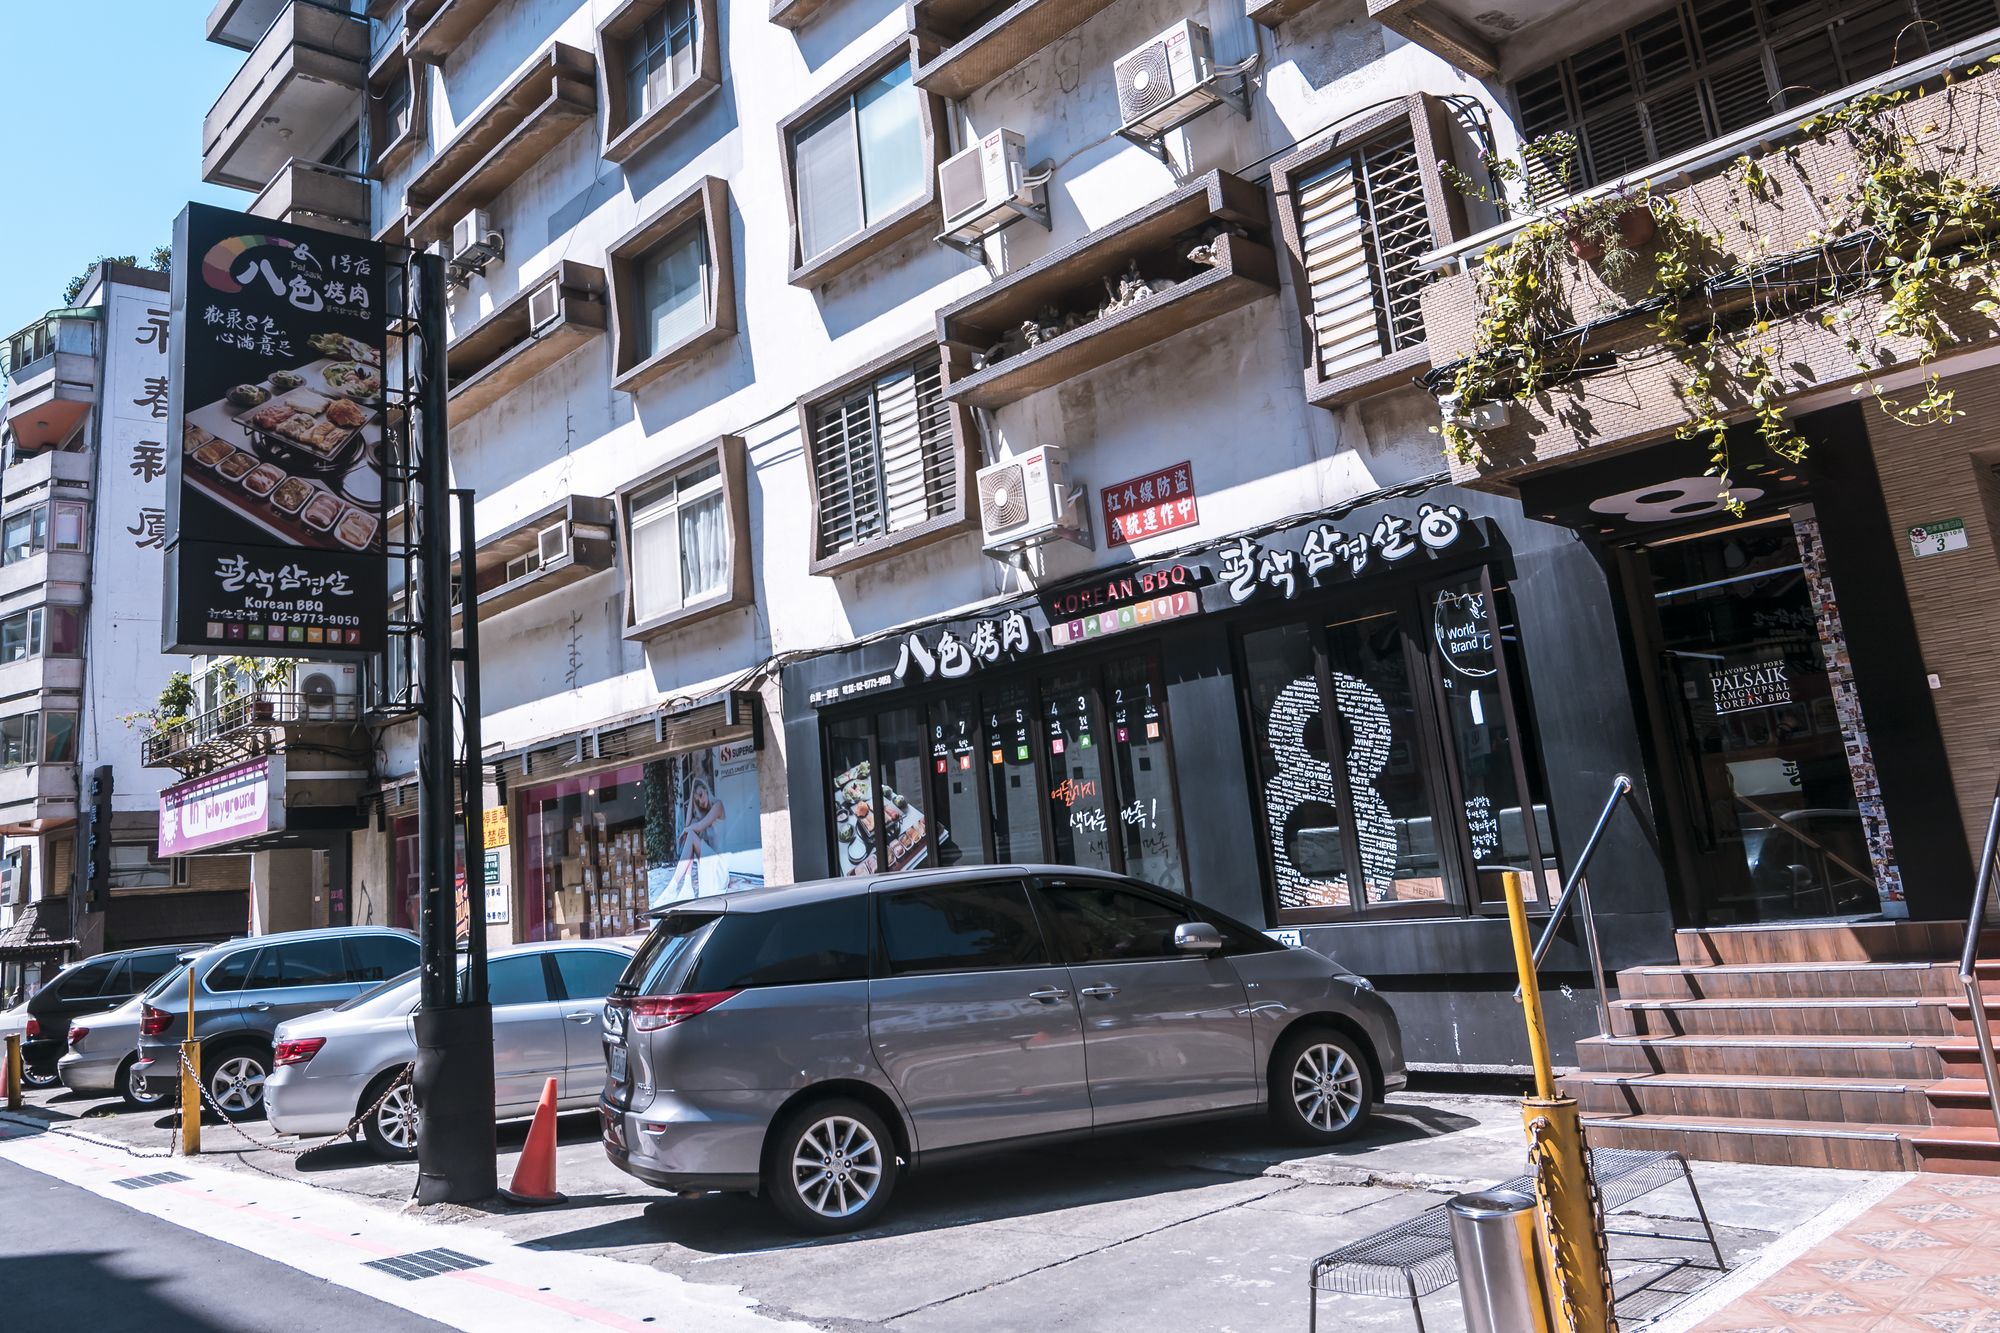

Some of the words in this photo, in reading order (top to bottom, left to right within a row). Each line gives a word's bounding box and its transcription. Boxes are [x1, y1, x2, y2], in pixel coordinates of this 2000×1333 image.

[237, 258, 370, 312] 八色烤肉
[1107, 468, 1190, 513] 紅外線防盜
[1111, 497, 1193, 542] 系統運作中
[1936, 538, 1945, 552] 3
[1218, 513, 1417, 604] 팔색삼겹살
[214, 554, 354, 598] 팔색삼겹살
[1053, 578, 1134, 617] KOREAN
[1143, 564, 1187, 593] BBQ
[245, 596, 294, 611] Korean
[296, 599, 324, 612] BBQ
[272, 612, 360, 625] 02-8773-9050
[1446, 621, 1476, 640] World
[894, 609, 1030, 679] 八色烤肉
[1450, 636, 1478, 654] Brand
[1715, 666, 1748, 677] FLAVORS
[1750, 663, 1760, 671] OF
[1763, 660, 1785, 668] PORK
[1340, 681, 1367, 690] CURRY
[1711, 666, 1788, 693] PALSAIK
[1115, 689, 1123, 704] 2
[1145, 683, 1152, 698] 1
[1714, 682, 1790, 702] SAMGYUPSAL
[1078, 696, 1085, 711] 3
[1715, 696, 1763, 711] KOREAN
[1768, 691, 1791, 702] BBQ
[1016, 709, 1023, 723] 5
[1051, 702, 1058, 716] 4
[959, 721, 965, 735] 7
[991, 714, 998, 727] 6
[936, 725, 942, 739] 8
[1378, 726, 1391, 735] Ajo
[1354, 737, 1374, 747] WINE
[1304, 770, 1332, 781] SOYBEA
[206, 783, 255, 829] playground
[1376, 840, 1397, 851] HERB
